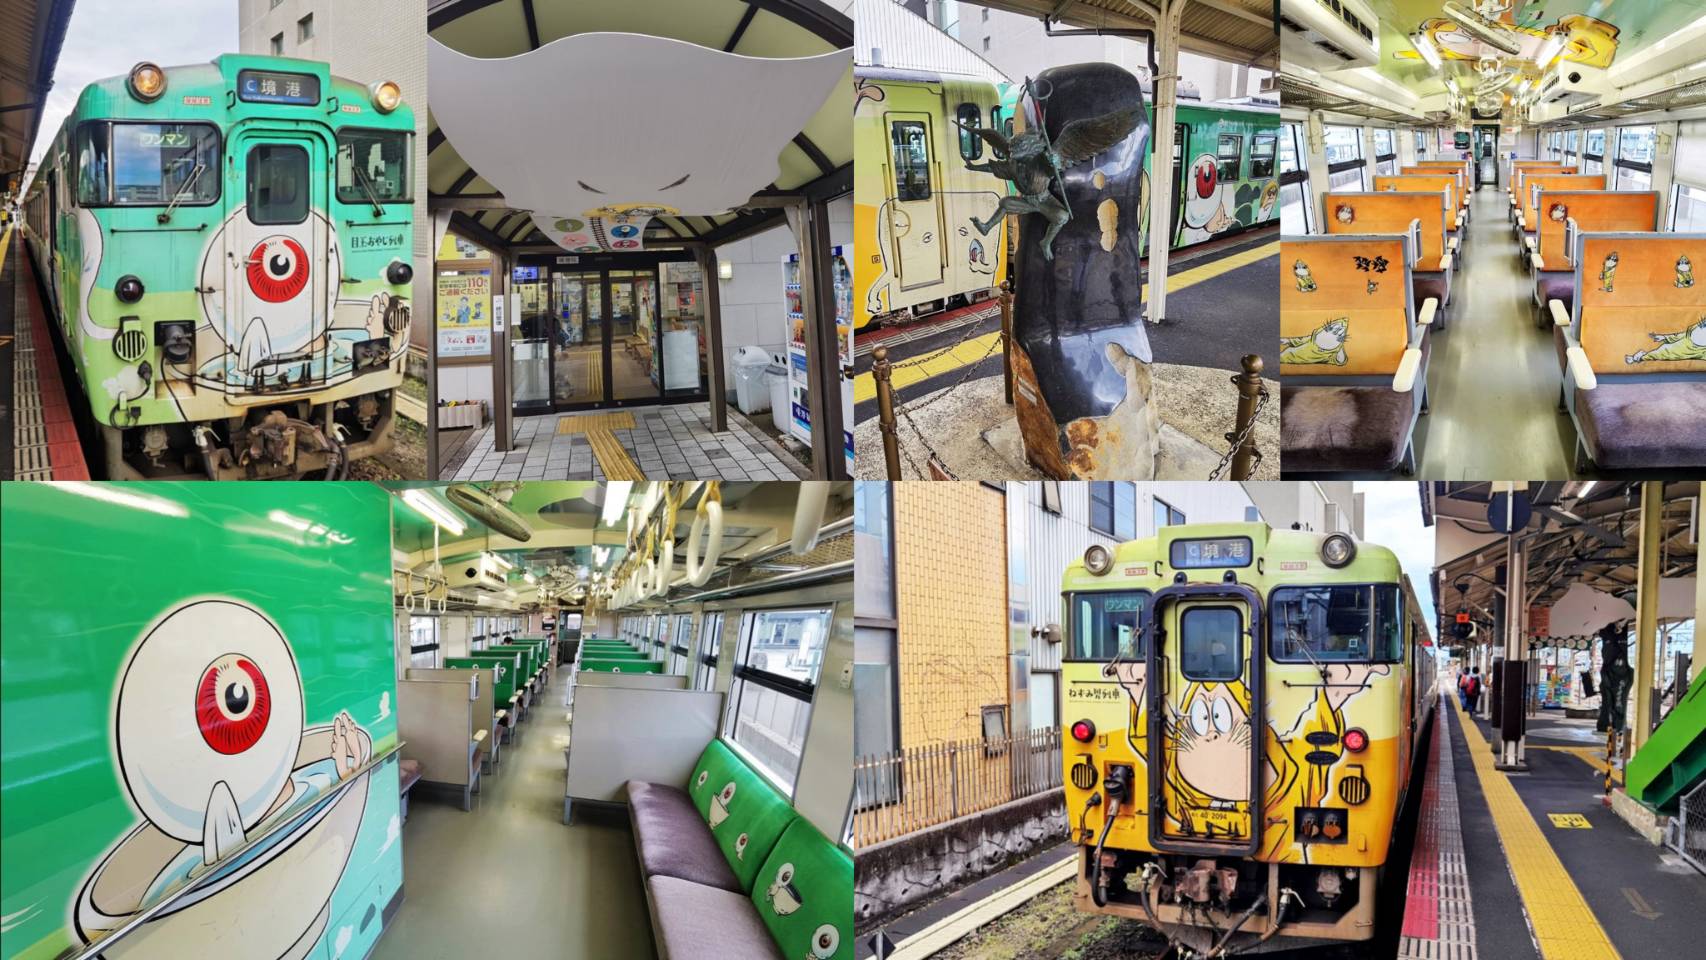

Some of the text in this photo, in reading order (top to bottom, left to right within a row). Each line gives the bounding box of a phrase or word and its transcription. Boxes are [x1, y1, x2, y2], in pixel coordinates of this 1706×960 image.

[261, 79, 301, 97] 境港
[142, 133, 188, 145] ワンマン
[351, 233, 404, 248] 目玉おやじ列車
[1202, 542, 1245, 559] 境港
[1106, 597, 1142, 610] ワンマン
